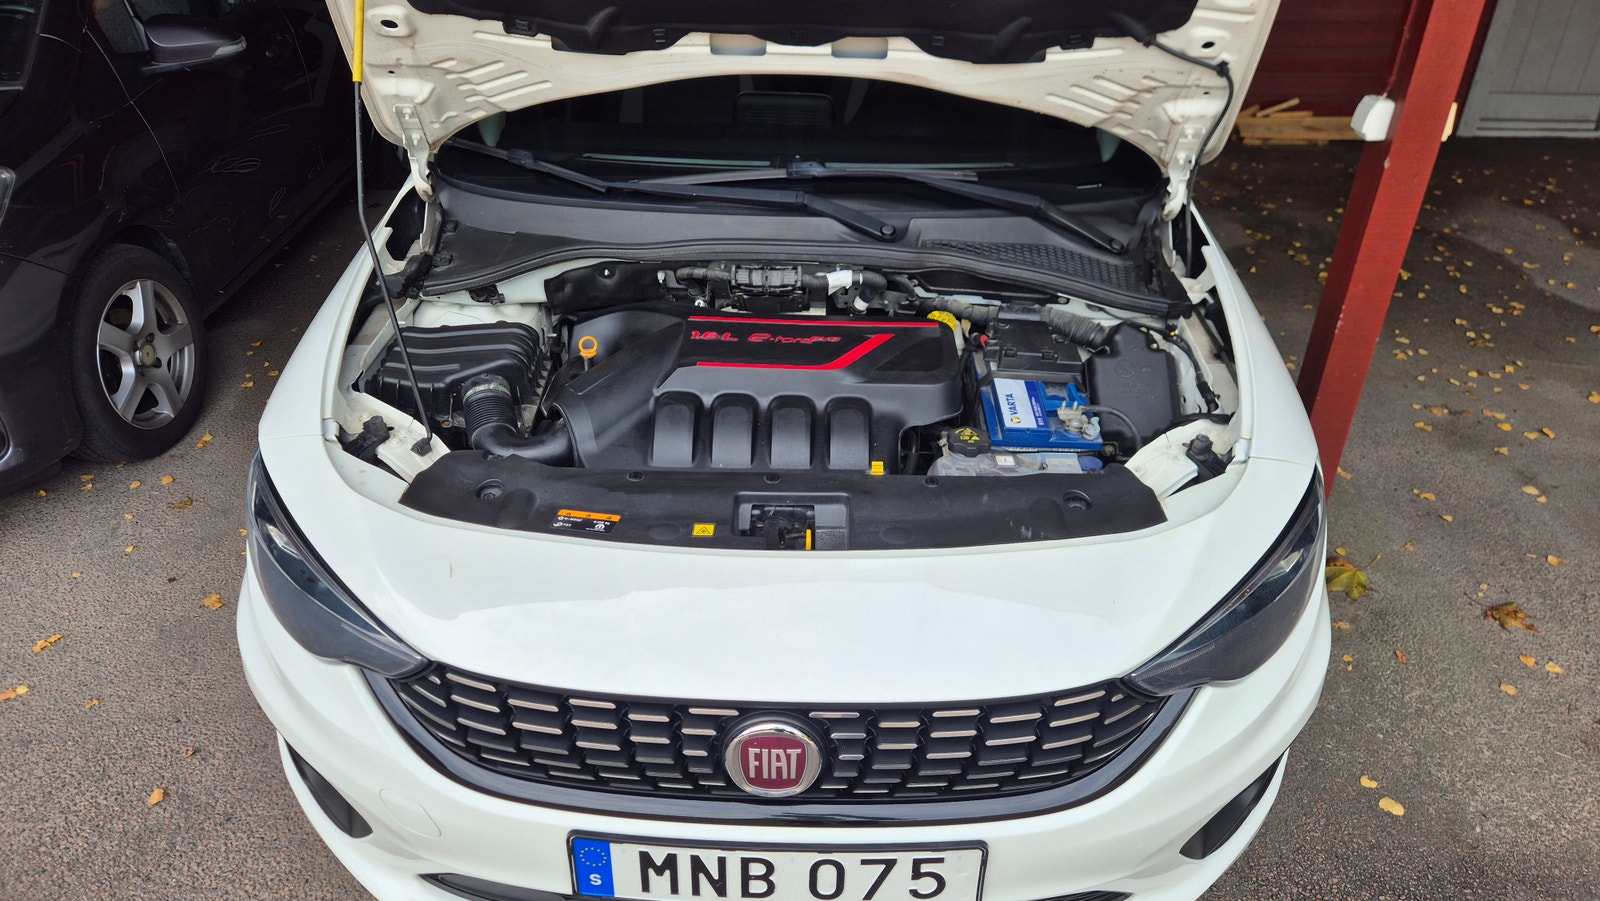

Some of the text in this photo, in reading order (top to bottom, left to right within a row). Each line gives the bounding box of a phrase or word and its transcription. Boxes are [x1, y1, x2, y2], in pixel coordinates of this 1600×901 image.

[1005, 393, 1019, 416] VARTA
[748, 748, 802, 780] FIAT
[589, 873, 602, 886] S
[638, 850, 946, 901] MNB 075
